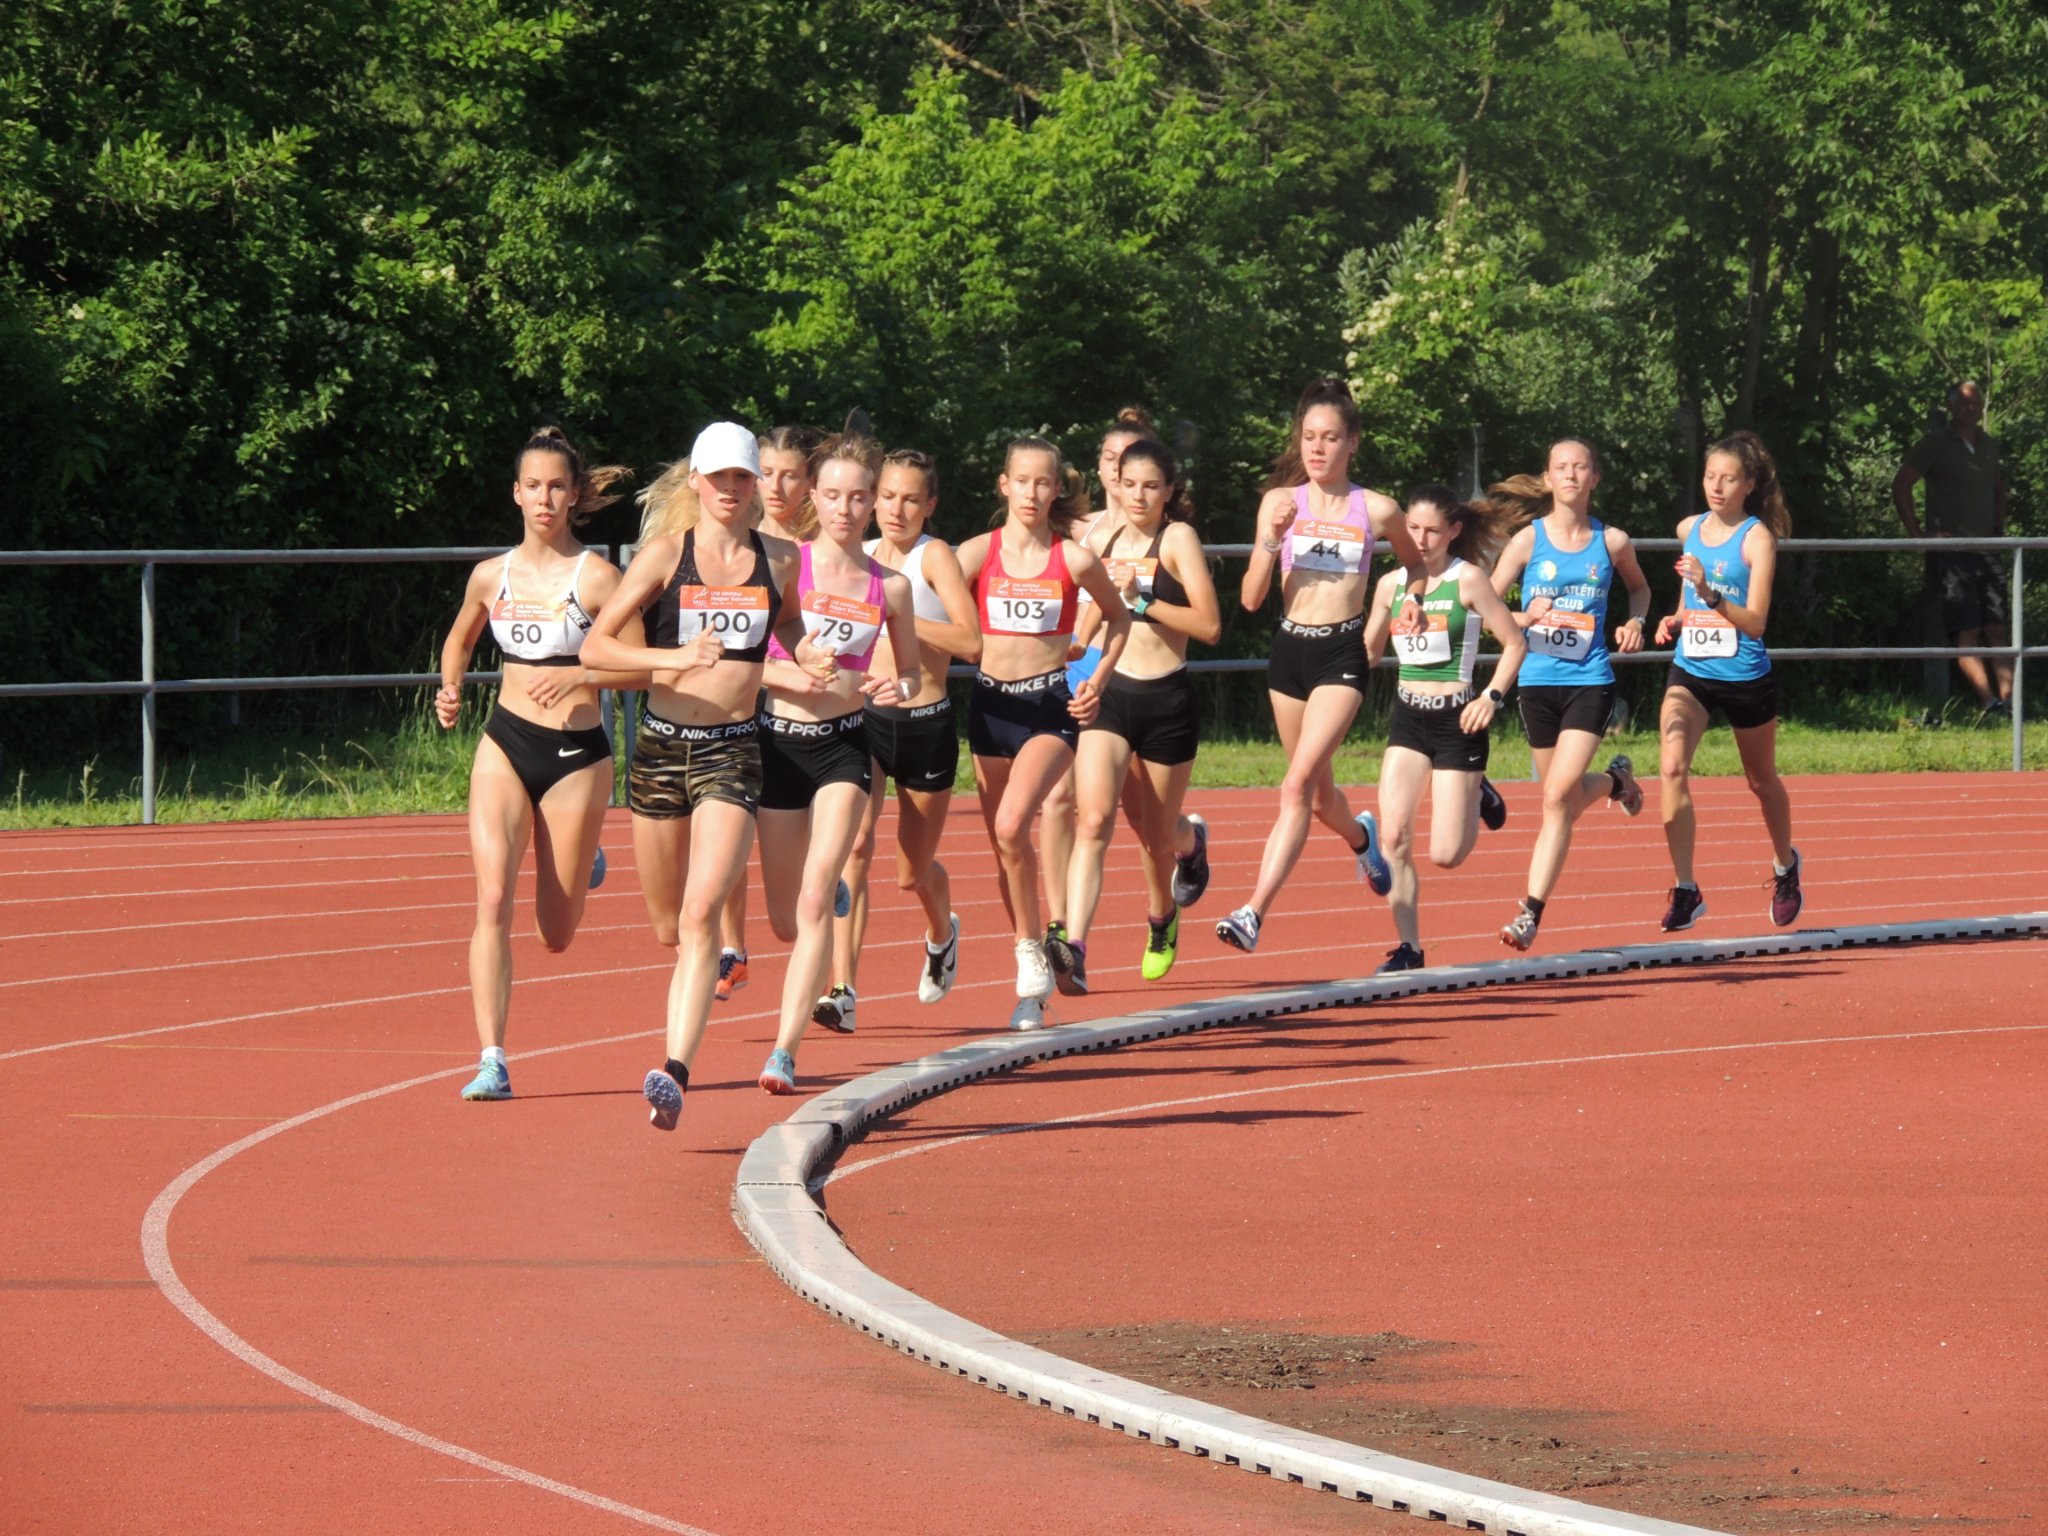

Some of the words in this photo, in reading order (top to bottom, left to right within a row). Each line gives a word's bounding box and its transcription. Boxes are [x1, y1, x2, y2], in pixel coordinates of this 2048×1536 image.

[1310, 540, 1341, 558] 44
[1003, 599, 1045, 620] 103
[1555, 597, 1585, 611] CLUB
[698, 611, 751, 633] 100
[821, 618, 853, 642] 79
[511, 623, 542, 644] 60
[1293, 626, 1333, 638] PRO
[1543, 628, 1578, 647] 105
[1689, 629, 1722, 645] 104
[1405, 635, 1428, 653] 30
[1001, 676, 1046, 694] NIKE
[1410, 693, 1446, 710] PRO
[910, 705, 935, 718] NIKE
[643, 714, 676, 735] PRO
[680, 727, 722, 740] NIKE
[724, 720, 755, 737] PRO
[788, 722, 833, 737] PRO
